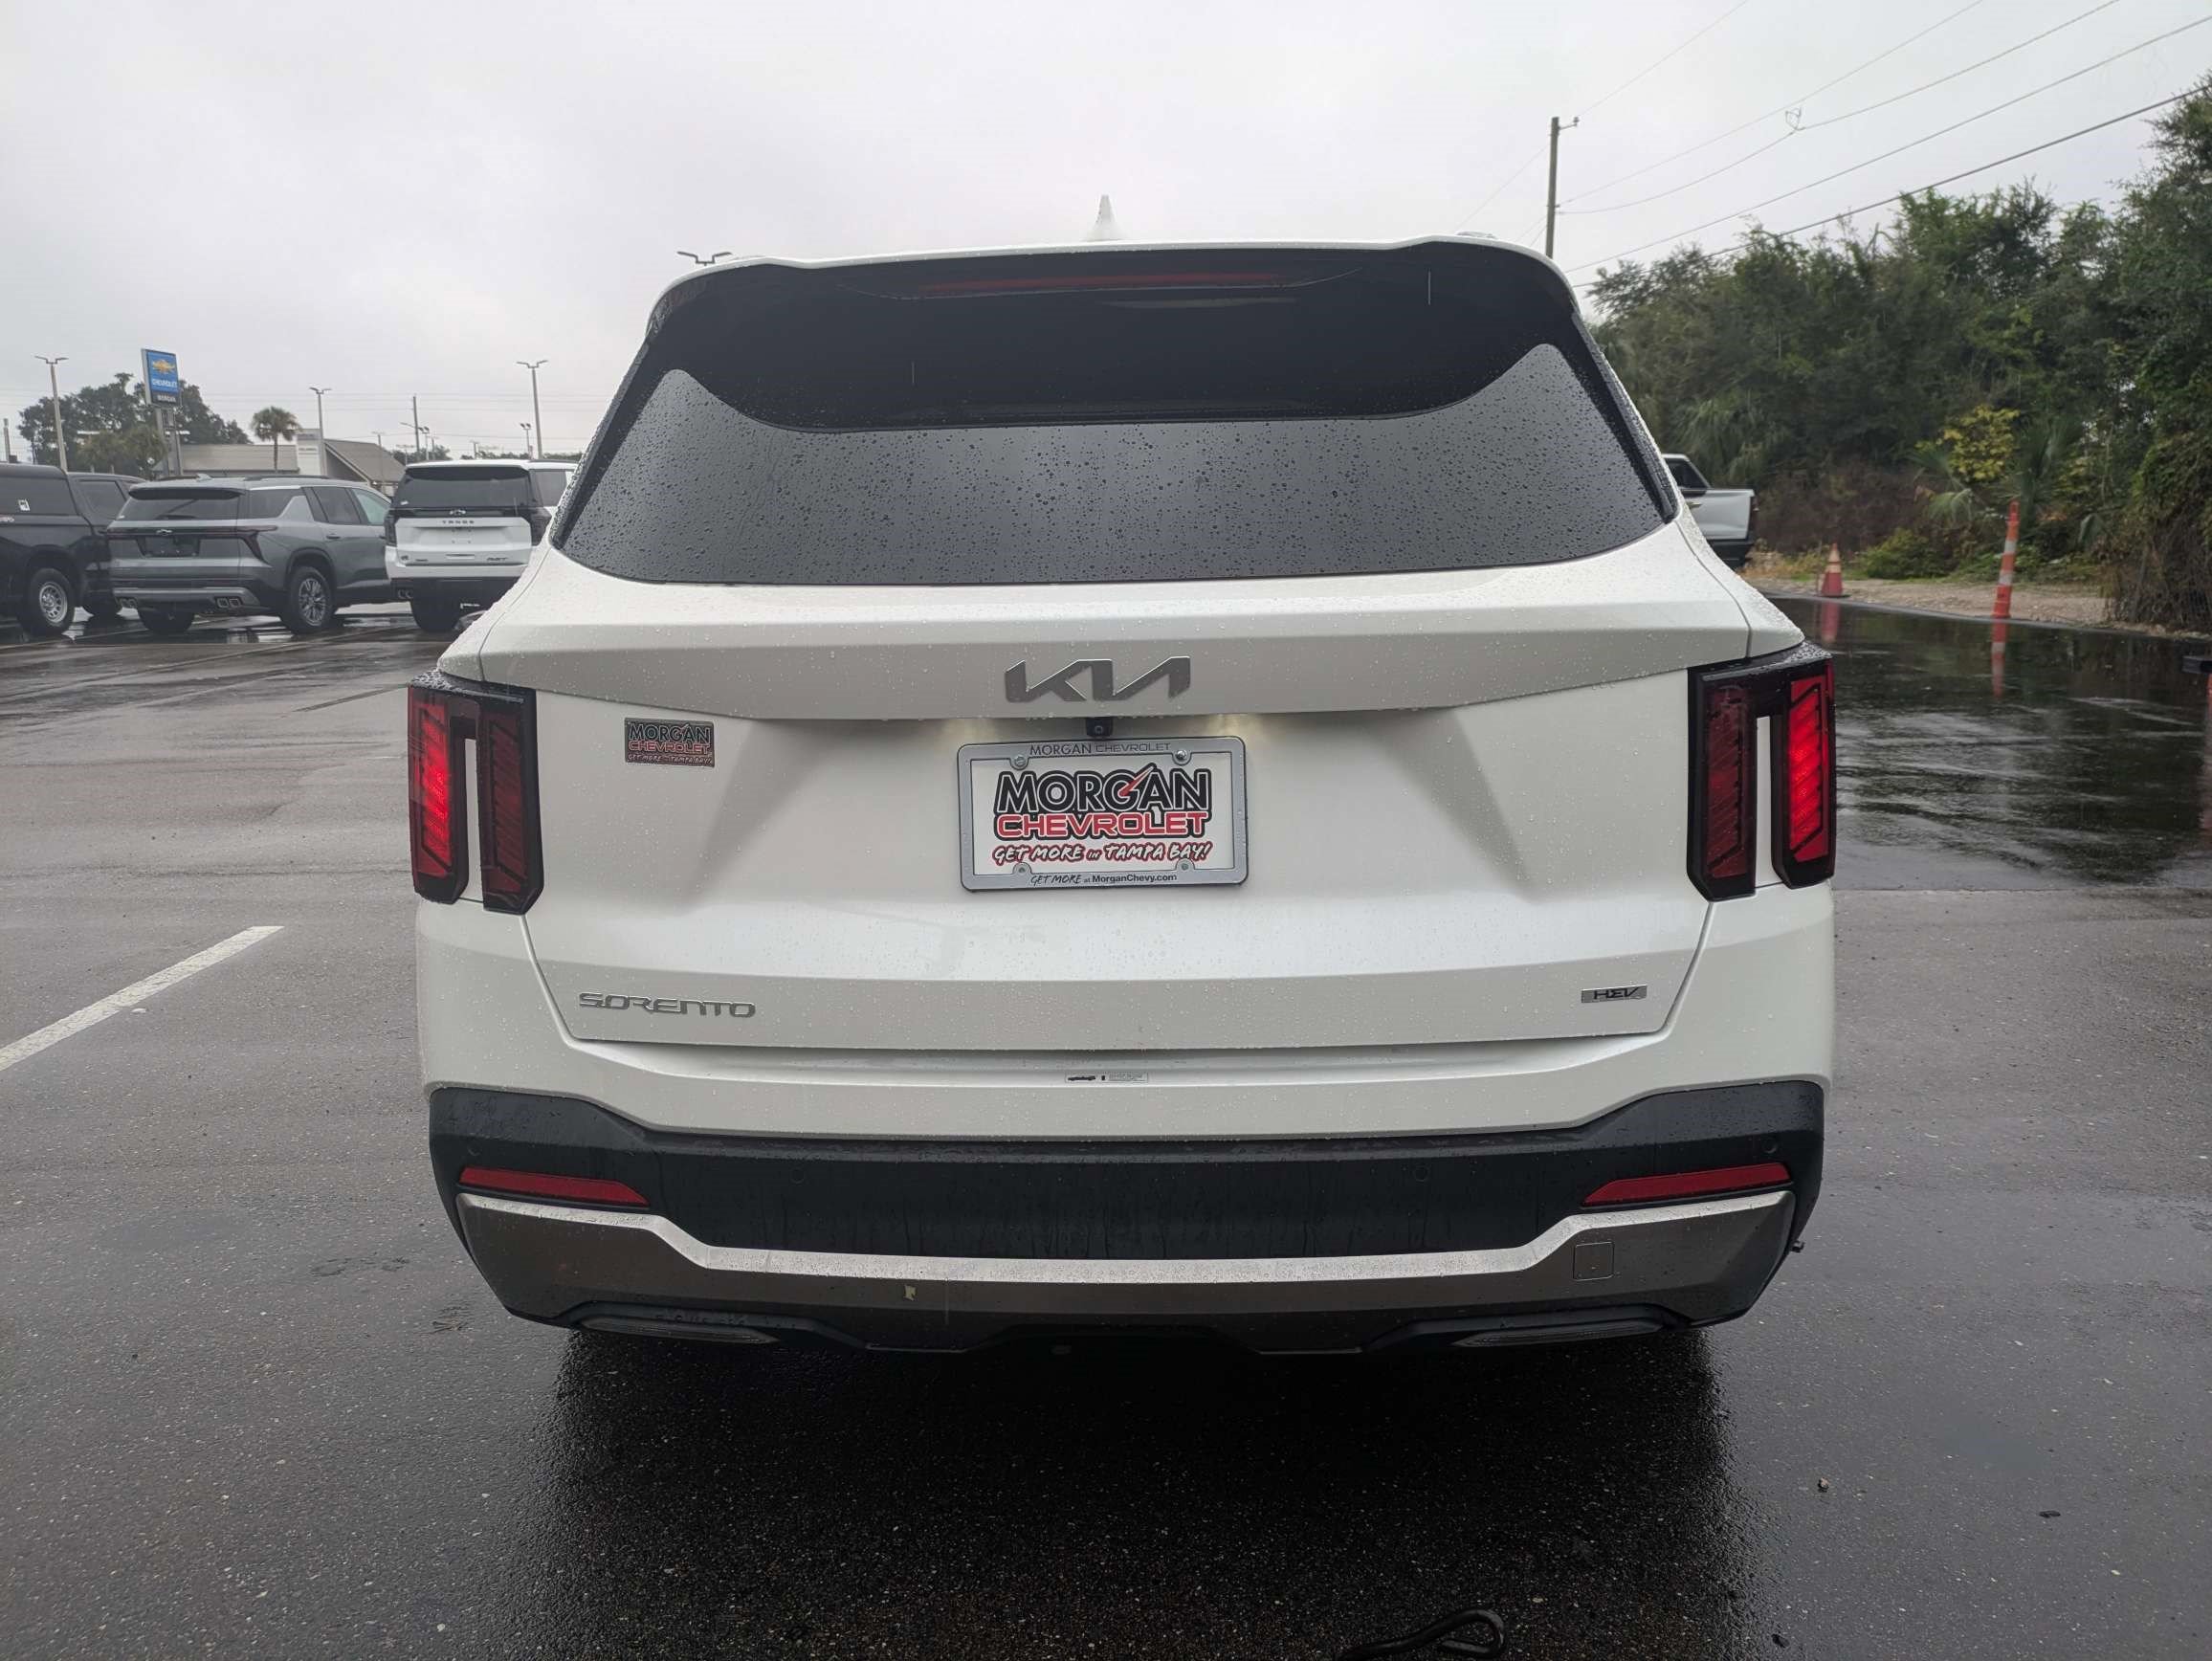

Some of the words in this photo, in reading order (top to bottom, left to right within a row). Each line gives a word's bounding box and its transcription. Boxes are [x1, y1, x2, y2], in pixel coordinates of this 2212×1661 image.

[1005, 655, 1191, 703] KIA
[628, 722, 711, 743] MORGAN
[629, 740, 712, 755] CHEVROLET
[1029, 742, 1092, 756] MORGAN
[1095, 742, 1171, 753] CHEVROLET
[995, 765, 1211, 813] MORGAN
[996, 811, 1209, 838] CHEVROLET
[993, 844, 1030, 865] GET
[1029, 843, 1085, 862] MORE
[1104, 842, 1166, 861] TAMPA
[1167, 841, 1213, 861] BAY!
[1030, 875, 1051, 887] GET
[1051, 875, 1081, 884] MORE
[1092, 874, 1178, 884] MorganChevy.com
[579, 992, 756, 1018] SORENTO
